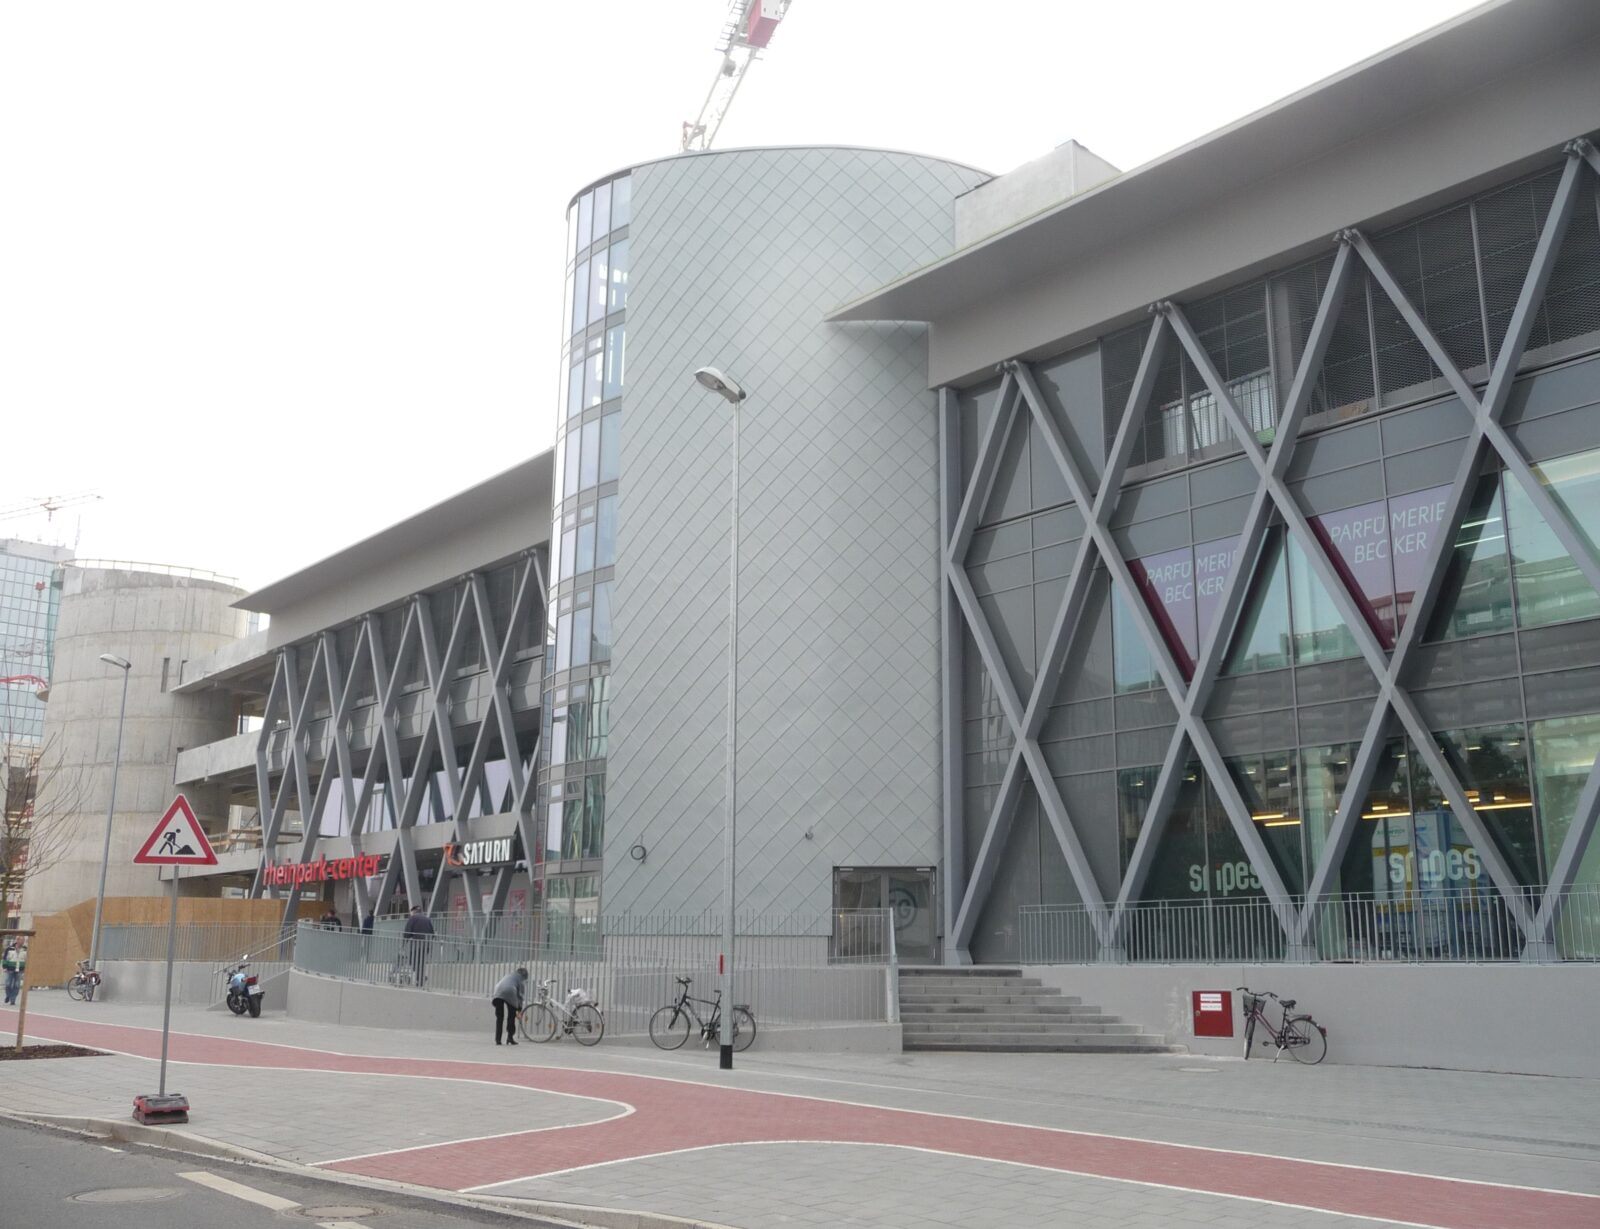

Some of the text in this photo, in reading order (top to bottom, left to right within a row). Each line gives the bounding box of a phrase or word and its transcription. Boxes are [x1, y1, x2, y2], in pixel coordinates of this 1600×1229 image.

[1354, 532, 1427, 564] BECKER
[1165, 576, 1225, 604] BECKER
[463, 839, 511, 866] SATURN
[262, 851, 381, 890] rheinpark-center
